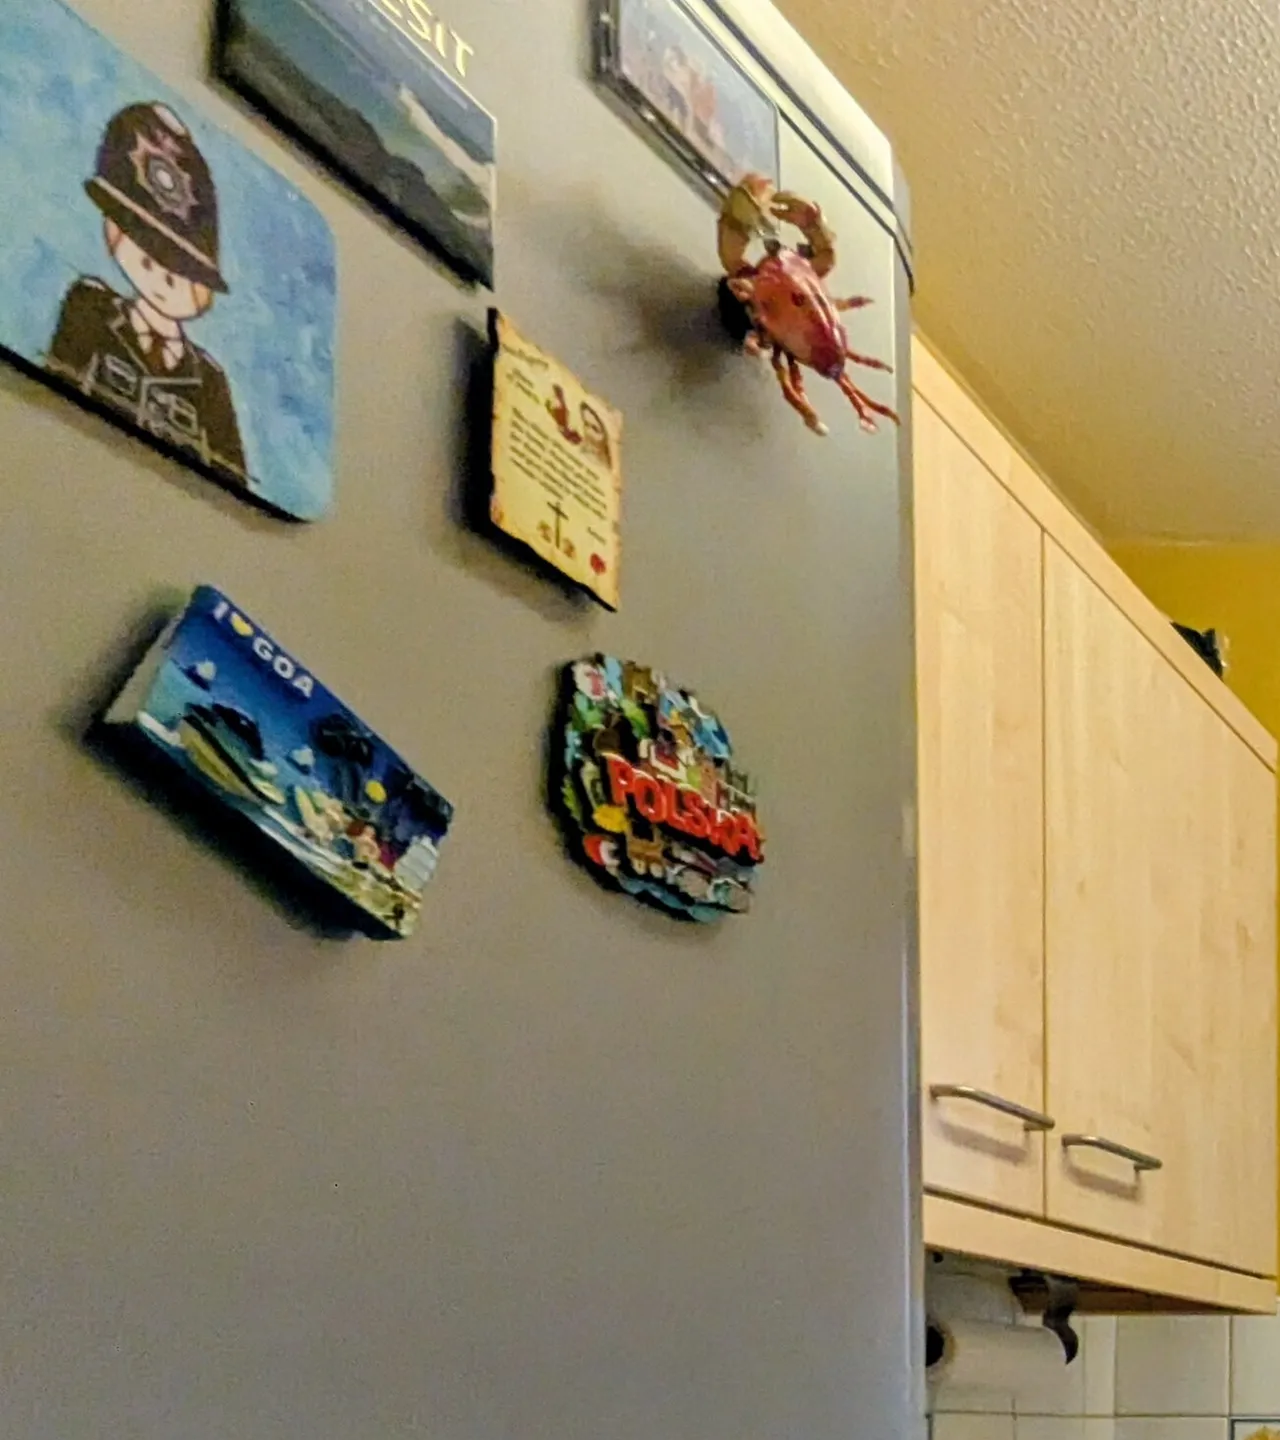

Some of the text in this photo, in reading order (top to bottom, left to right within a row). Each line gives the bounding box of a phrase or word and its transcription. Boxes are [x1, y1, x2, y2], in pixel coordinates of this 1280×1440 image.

[380, 0, 475, 78] SIT
[213, 601, 314, 698] I GOA
[603, 752, 764, 864] POLSKA
